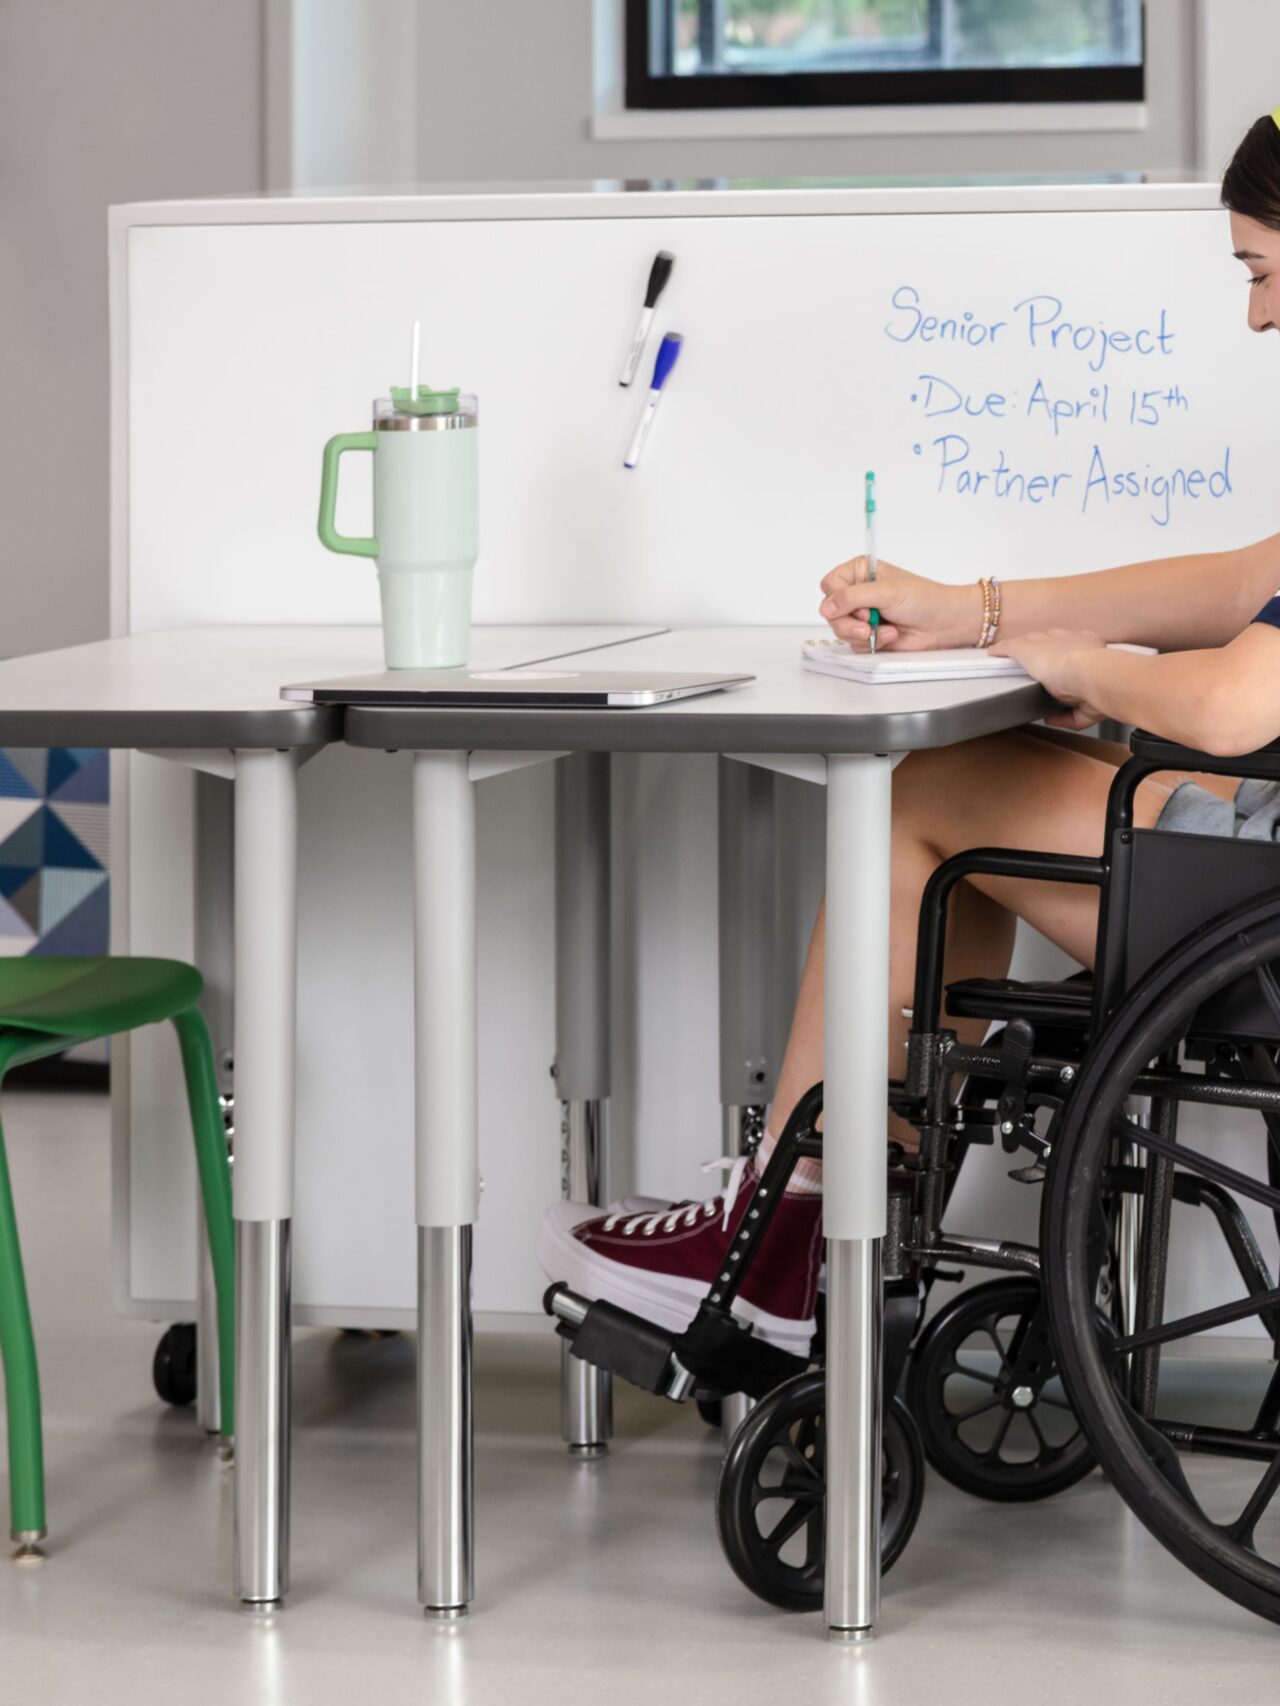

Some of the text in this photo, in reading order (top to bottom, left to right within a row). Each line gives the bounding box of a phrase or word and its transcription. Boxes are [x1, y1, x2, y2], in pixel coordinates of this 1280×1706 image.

[884, 285, 1175, 372] Senior Project
[1026, 377, 1110, 435] April
[1129, 384, 1189, 428] 15th
[933, 433, 1234, 527] Partner Assigned
